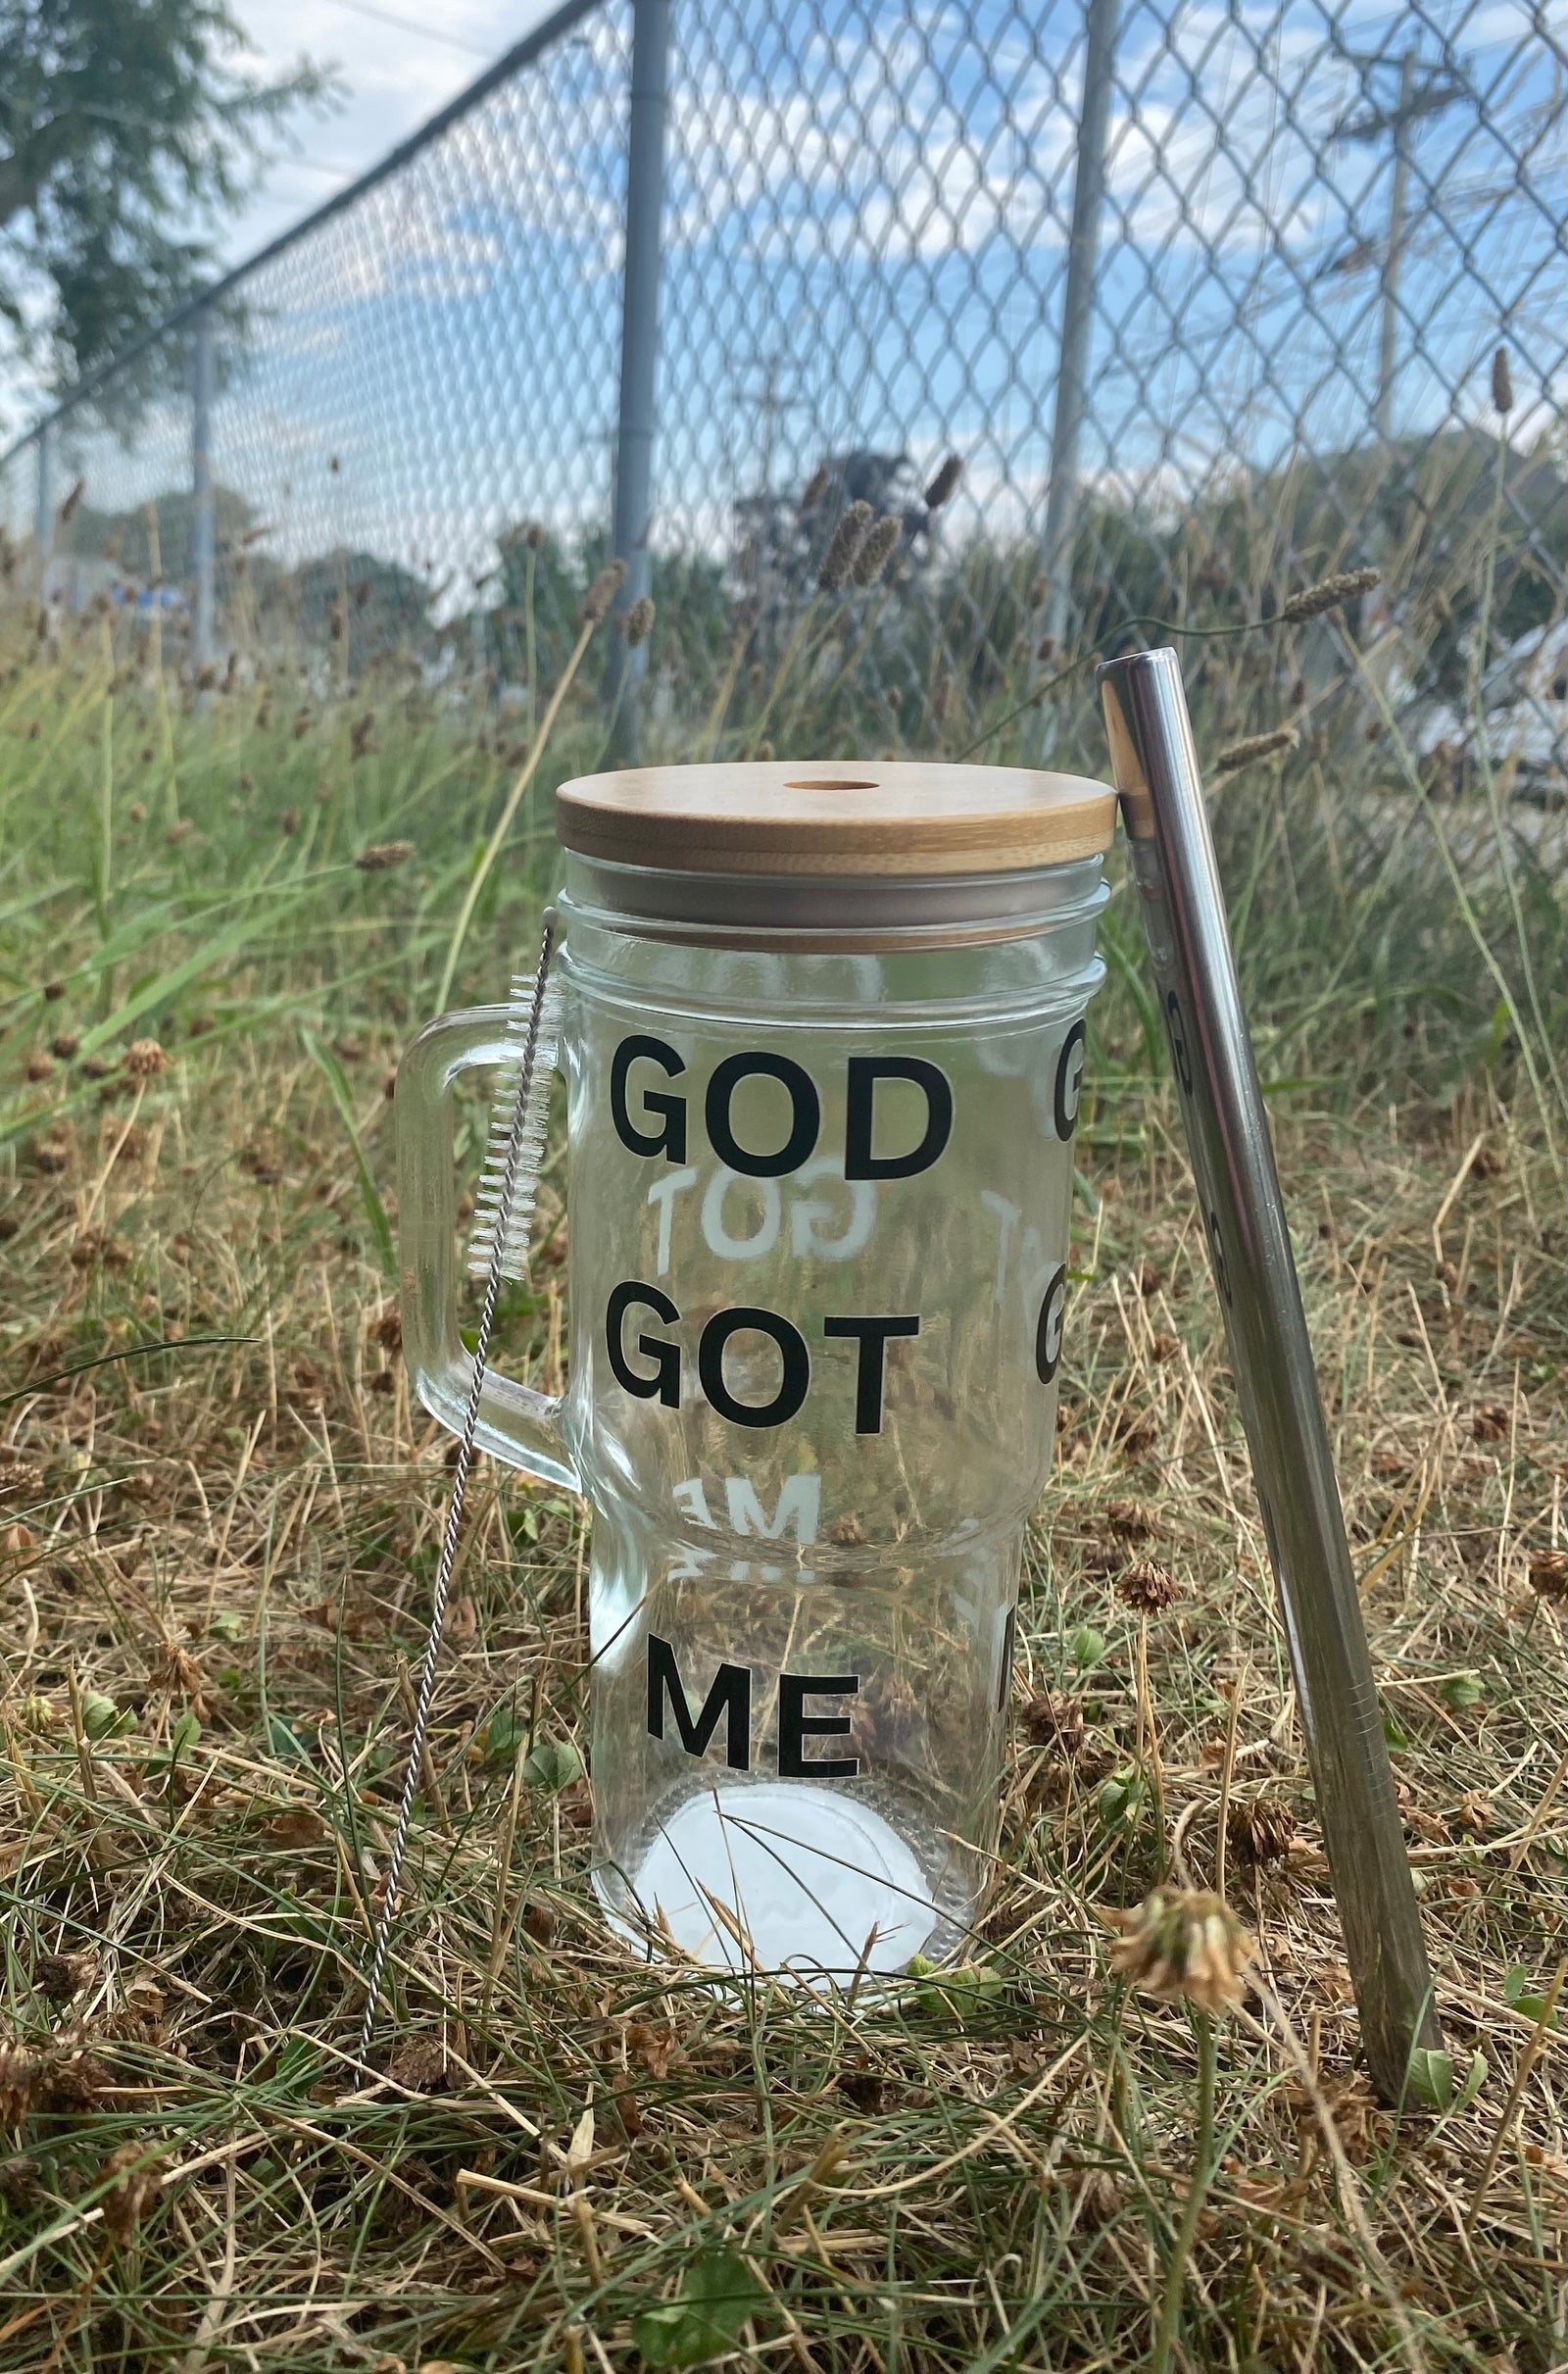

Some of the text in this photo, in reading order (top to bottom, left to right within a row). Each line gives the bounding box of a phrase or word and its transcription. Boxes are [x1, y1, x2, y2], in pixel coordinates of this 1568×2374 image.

[611, 1035, 953, 1181] GOD
[606, 1281, 921, 1435] GOT
[647, 1632, 859, 1779] ME
